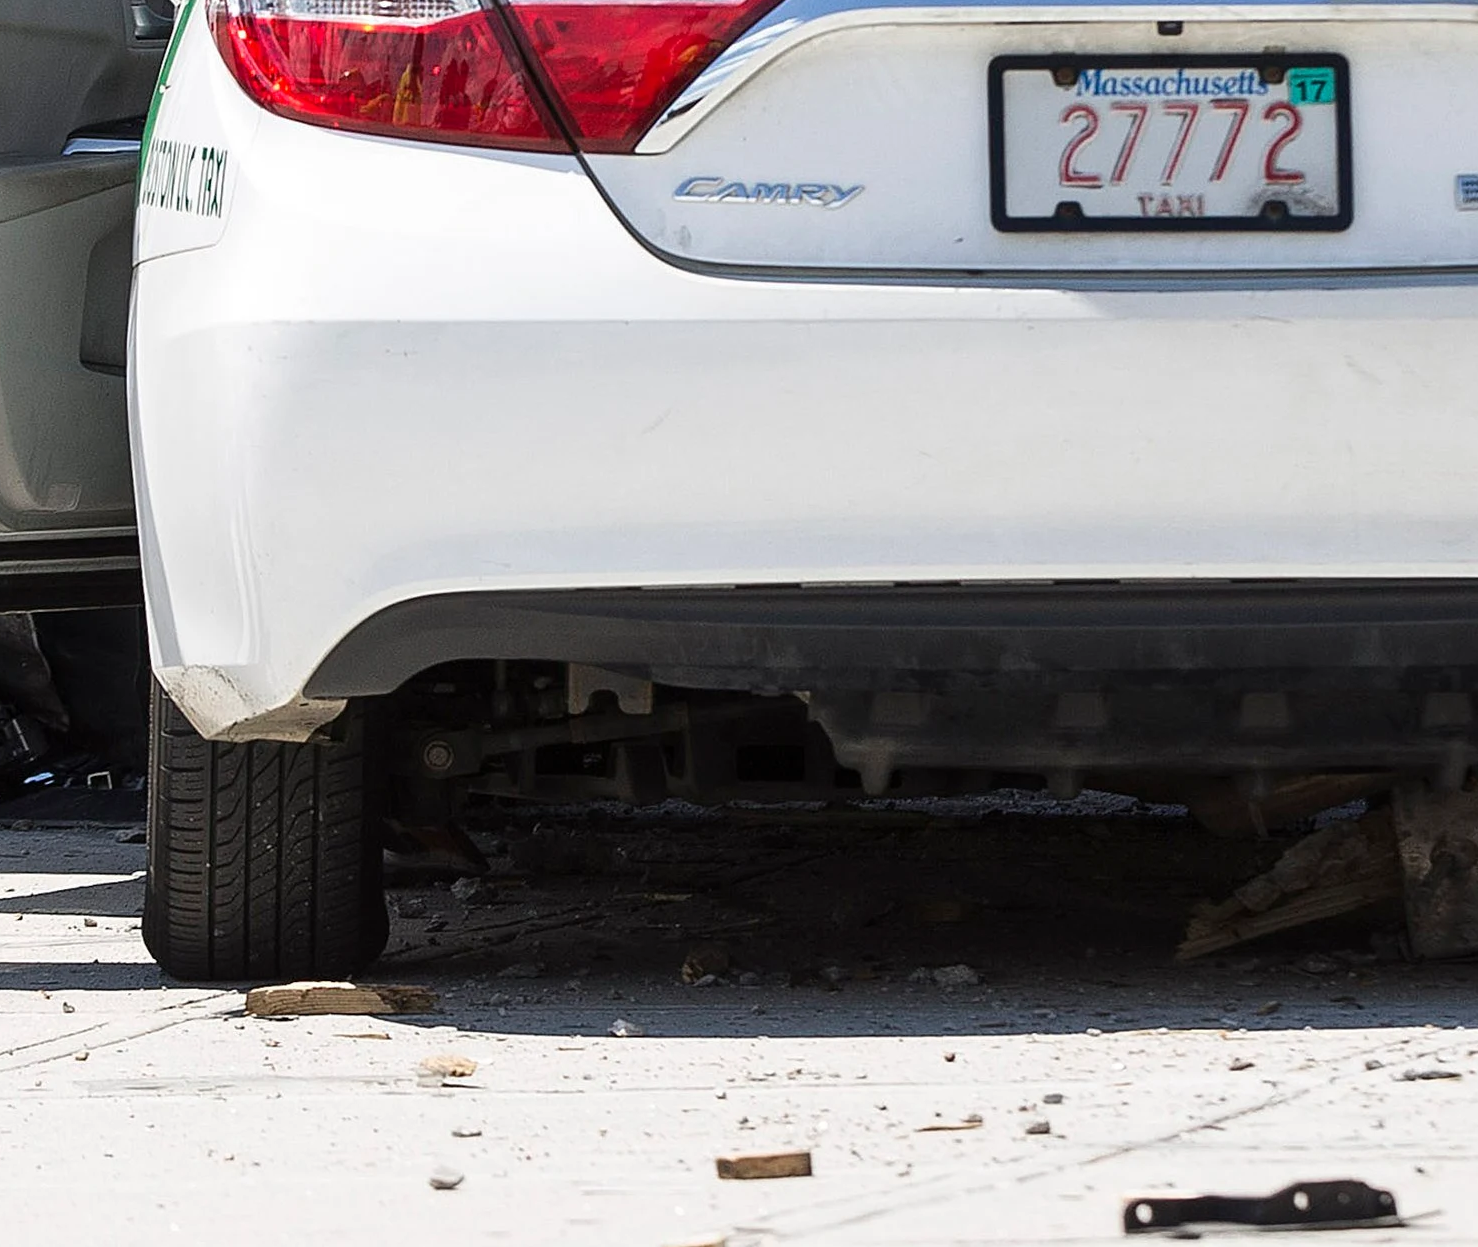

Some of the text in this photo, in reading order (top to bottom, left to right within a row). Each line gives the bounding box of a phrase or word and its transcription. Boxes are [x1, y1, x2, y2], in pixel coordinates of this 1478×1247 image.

[1077, 70, 1268, 98] Massachusetts
[1296, 80, 1324, 102] 17
[1060, 99, 1307, 187] 27772
[673, 176, 866, 211] CAMRY
[1137, 194, 1205, 216] TAXI
